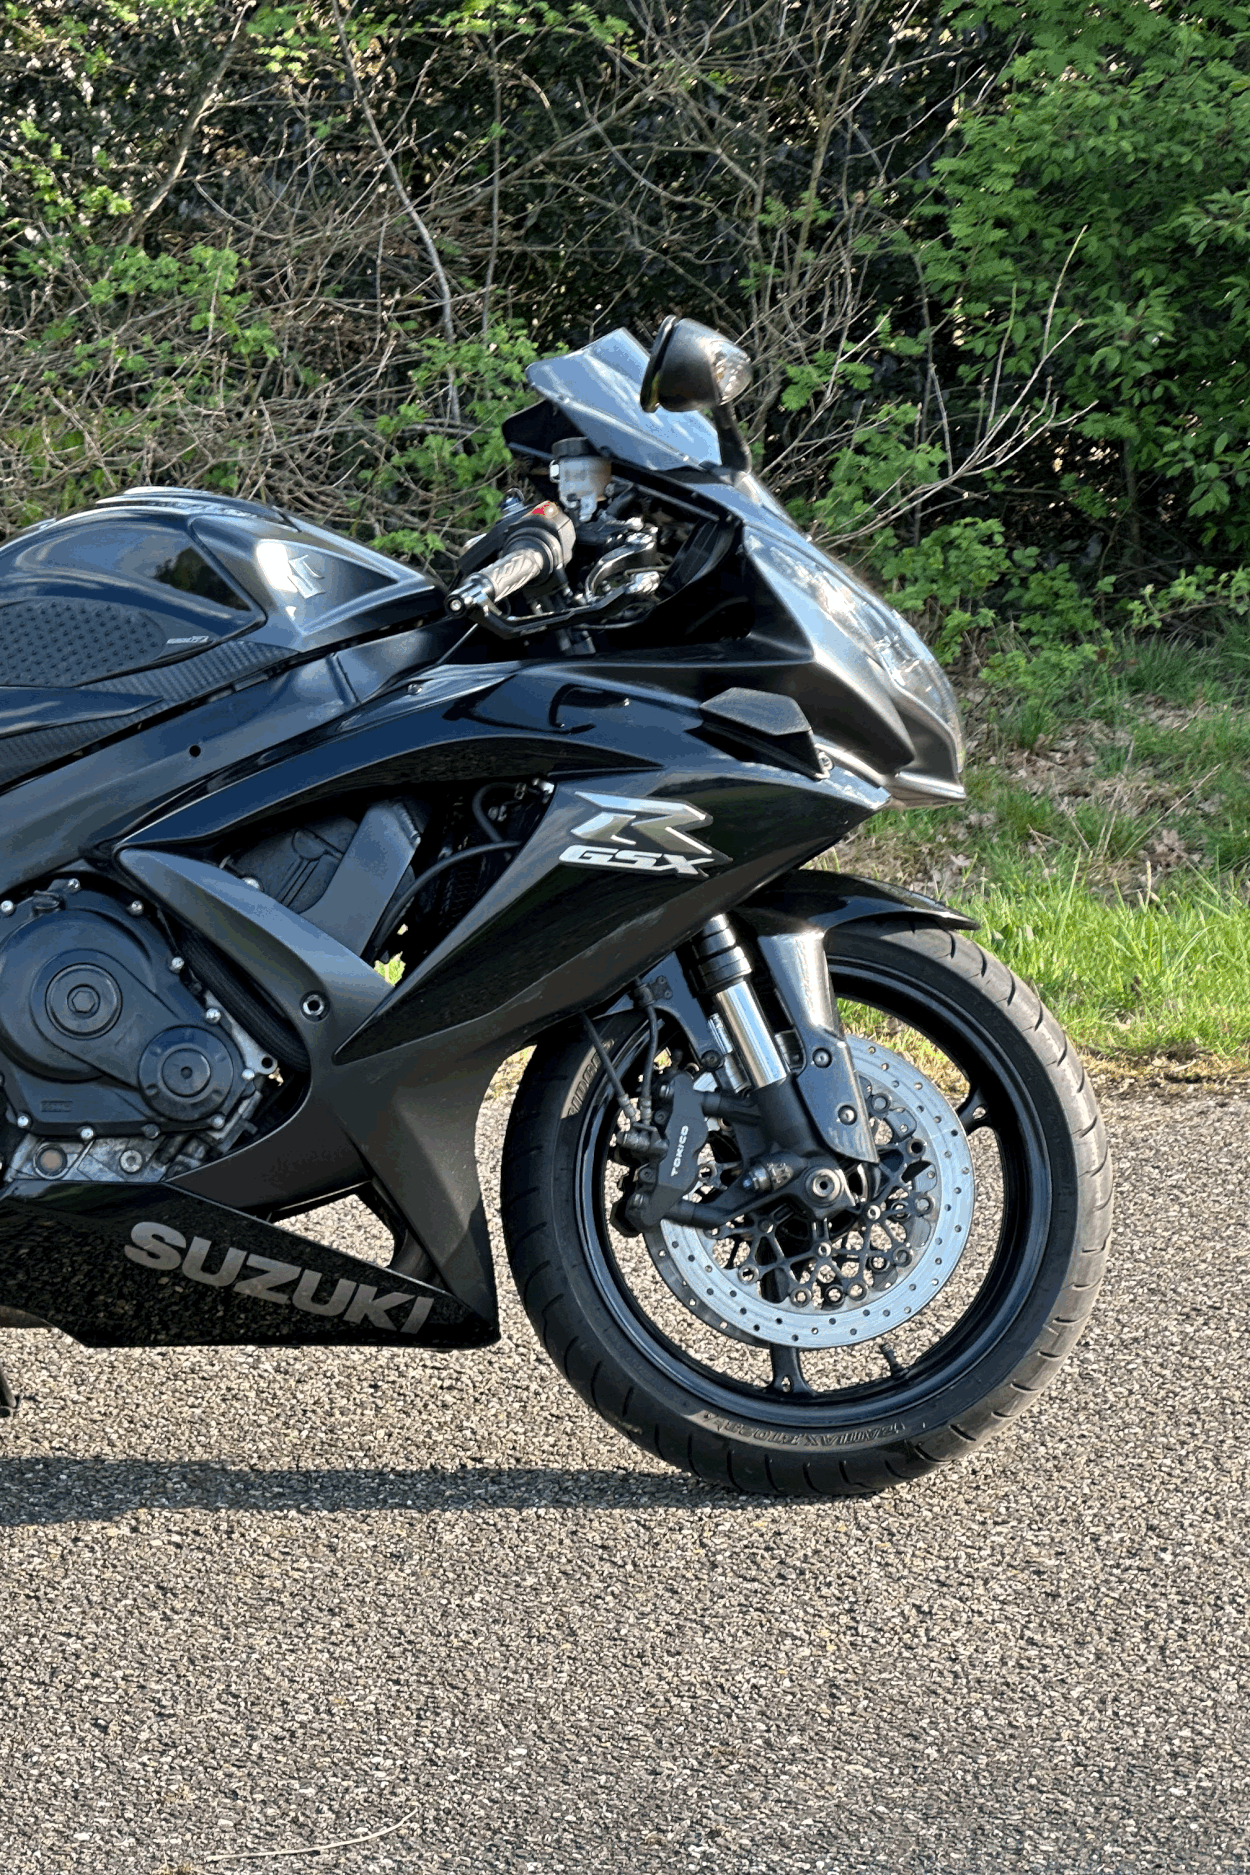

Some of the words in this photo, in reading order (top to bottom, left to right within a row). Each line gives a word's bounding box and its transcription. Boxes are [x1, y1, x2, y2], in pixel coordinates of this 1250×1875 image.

[559, 844, 716, 875] GSX
[670, 1125, 689, 1177] TOKICO
[124, 1221, 435, 1335] SUZUKI
